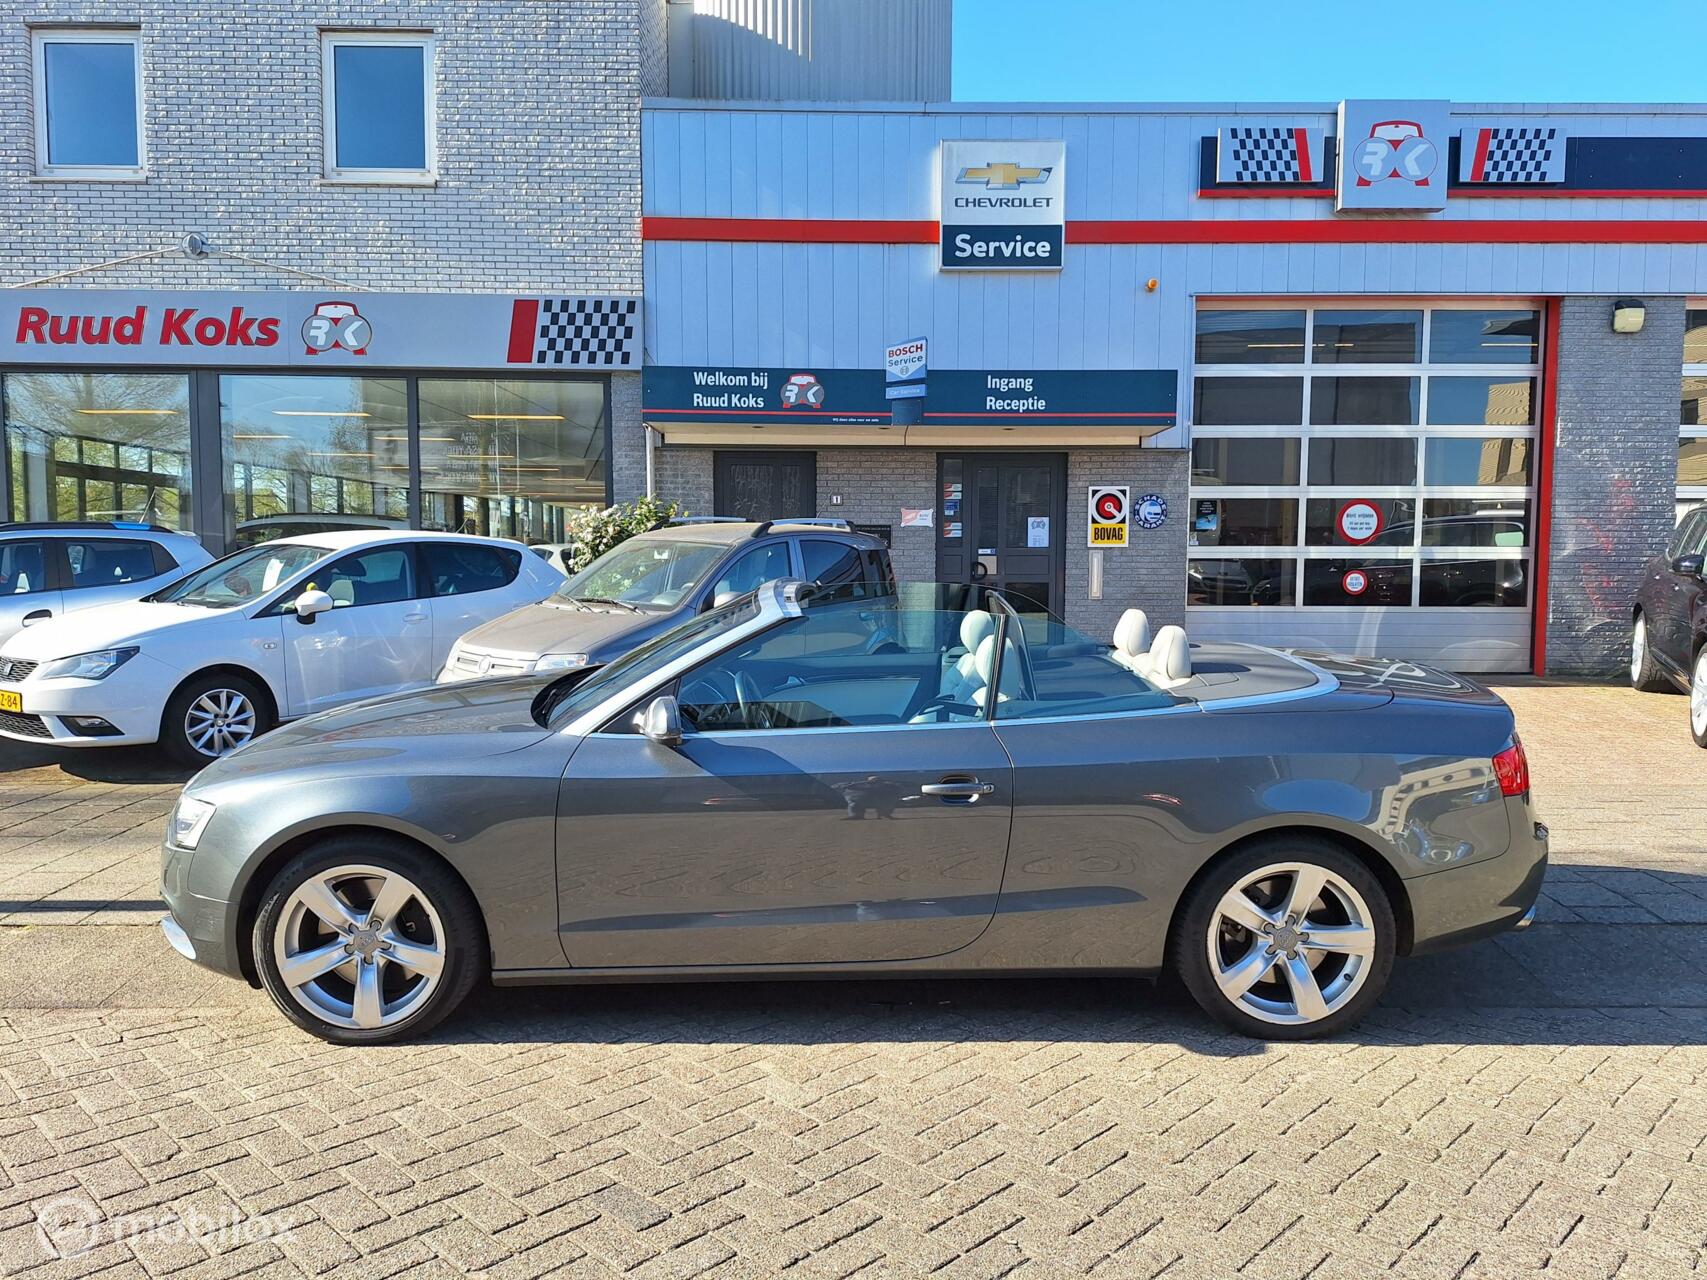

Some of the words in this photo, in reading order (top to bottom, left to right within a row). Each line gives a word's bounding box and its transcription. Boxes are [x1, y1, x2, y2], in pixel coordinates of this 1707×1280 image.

[954, 197, 1053, 208] CHEVROLET
[955, 233, 1051, 258] Service
[16, 305, 148, 345] Ruud
[159, 306, 281, 347] Koks
[888, 343, 923, 358] BOSCH
[887, 354, 924, 367] Service
[693, 371, 748, 387] Welkom
[751, 372, 768, 389] bij
[987, 374, 1034, 392] Ingang
[693, 392, 728, 407] Ruud
[731, 393, 765, 408] Koks
[986, 395, 1046, 413] Receptie
[1134, 495, 1167, 510] SCHADE
[1134, 516, 1166, 528] GARANT
[1094, 527, 1123, 541] BOVAG
